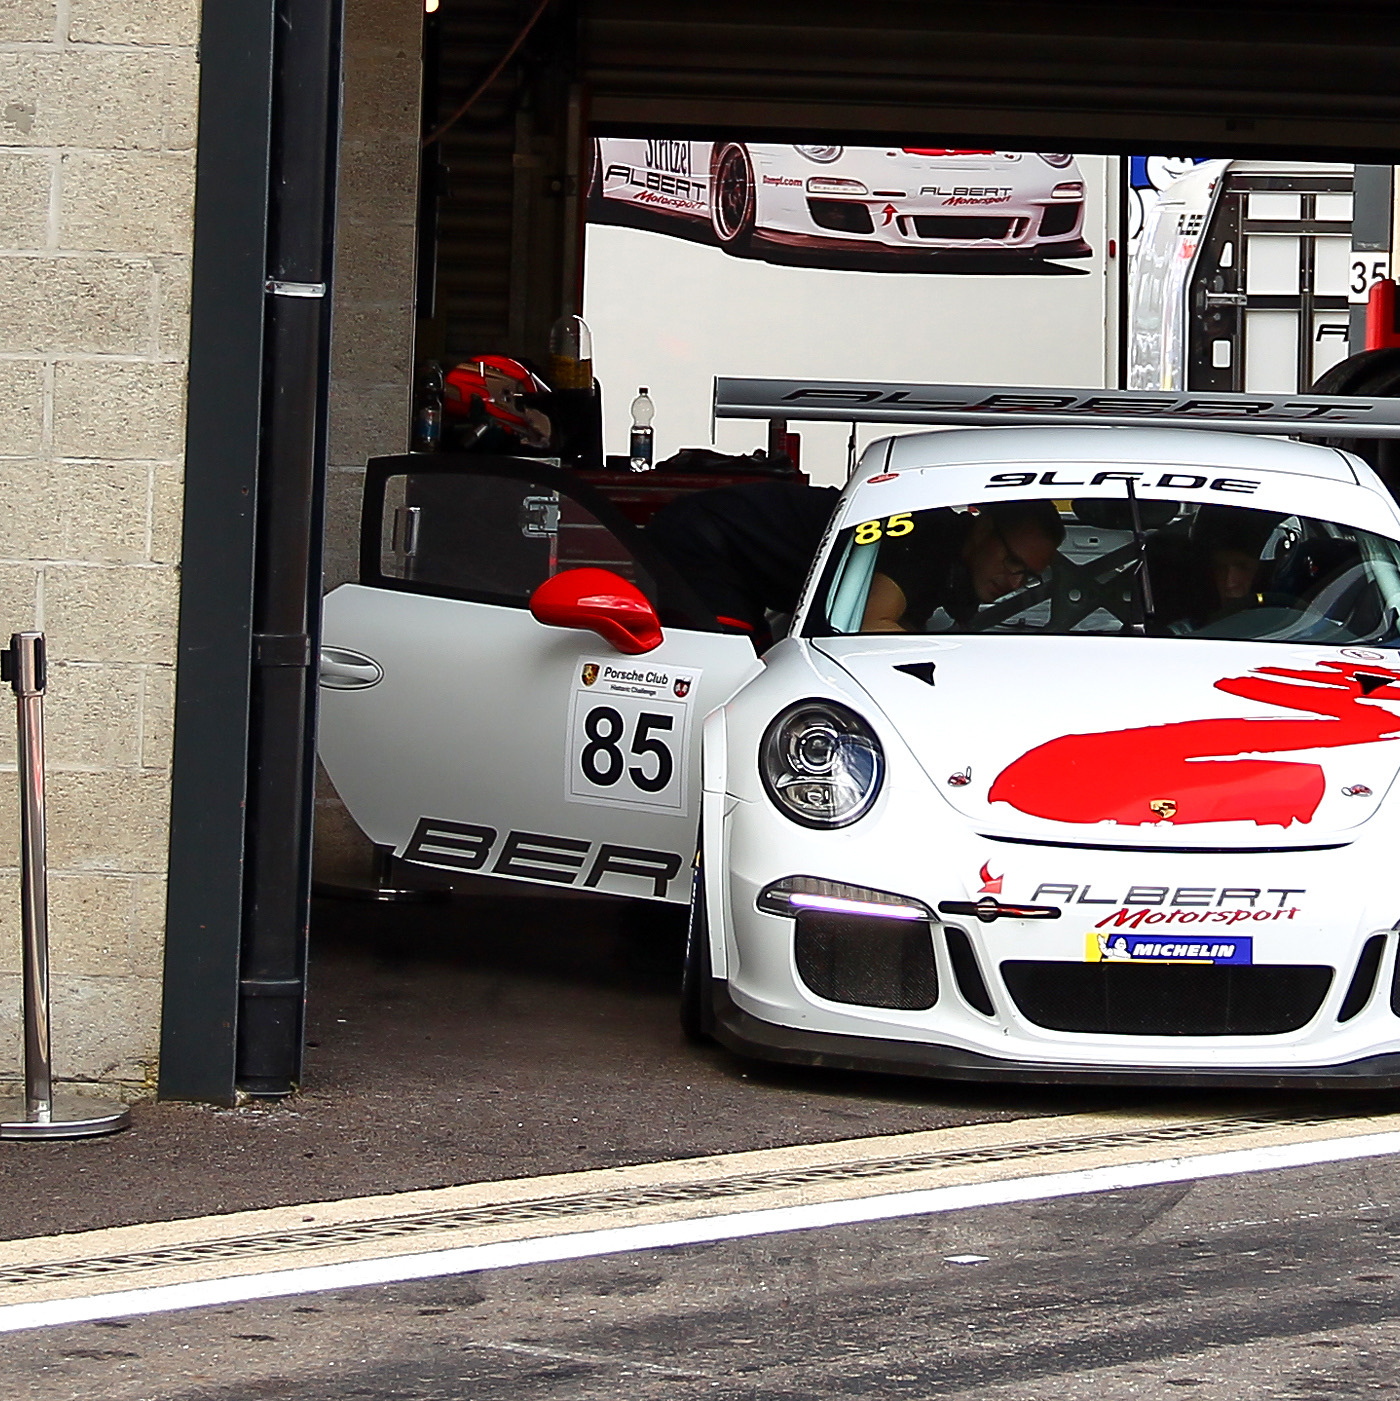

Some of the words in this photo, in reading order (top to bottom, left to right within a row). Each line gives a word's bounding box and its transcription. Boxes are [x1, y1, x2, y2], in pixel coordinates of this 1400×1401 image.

[605, 165, 707, 201] ALBERT
[919, 186, 1013, 197] ALBERT
[633, 190, 708, 210] Motorsport
[941, 195, 1012, 206] Motorsport
[1351, 261, 1387, 295] 35
[984, 471, 1262, 494] 9LF.DE
[854, 512, 915, 545] 85
[603, 666, 644, 681] Porsche
[646, 671, 669, 685] Club
[581, 706, 675, 794] 85
[401, 816, 683, 898] BER
[1030, 882, 1307, 908] ALBERT
[1094, 906, 1302, 929] Motorsport
[1132, 943, 1236, 959] MICHELIN
